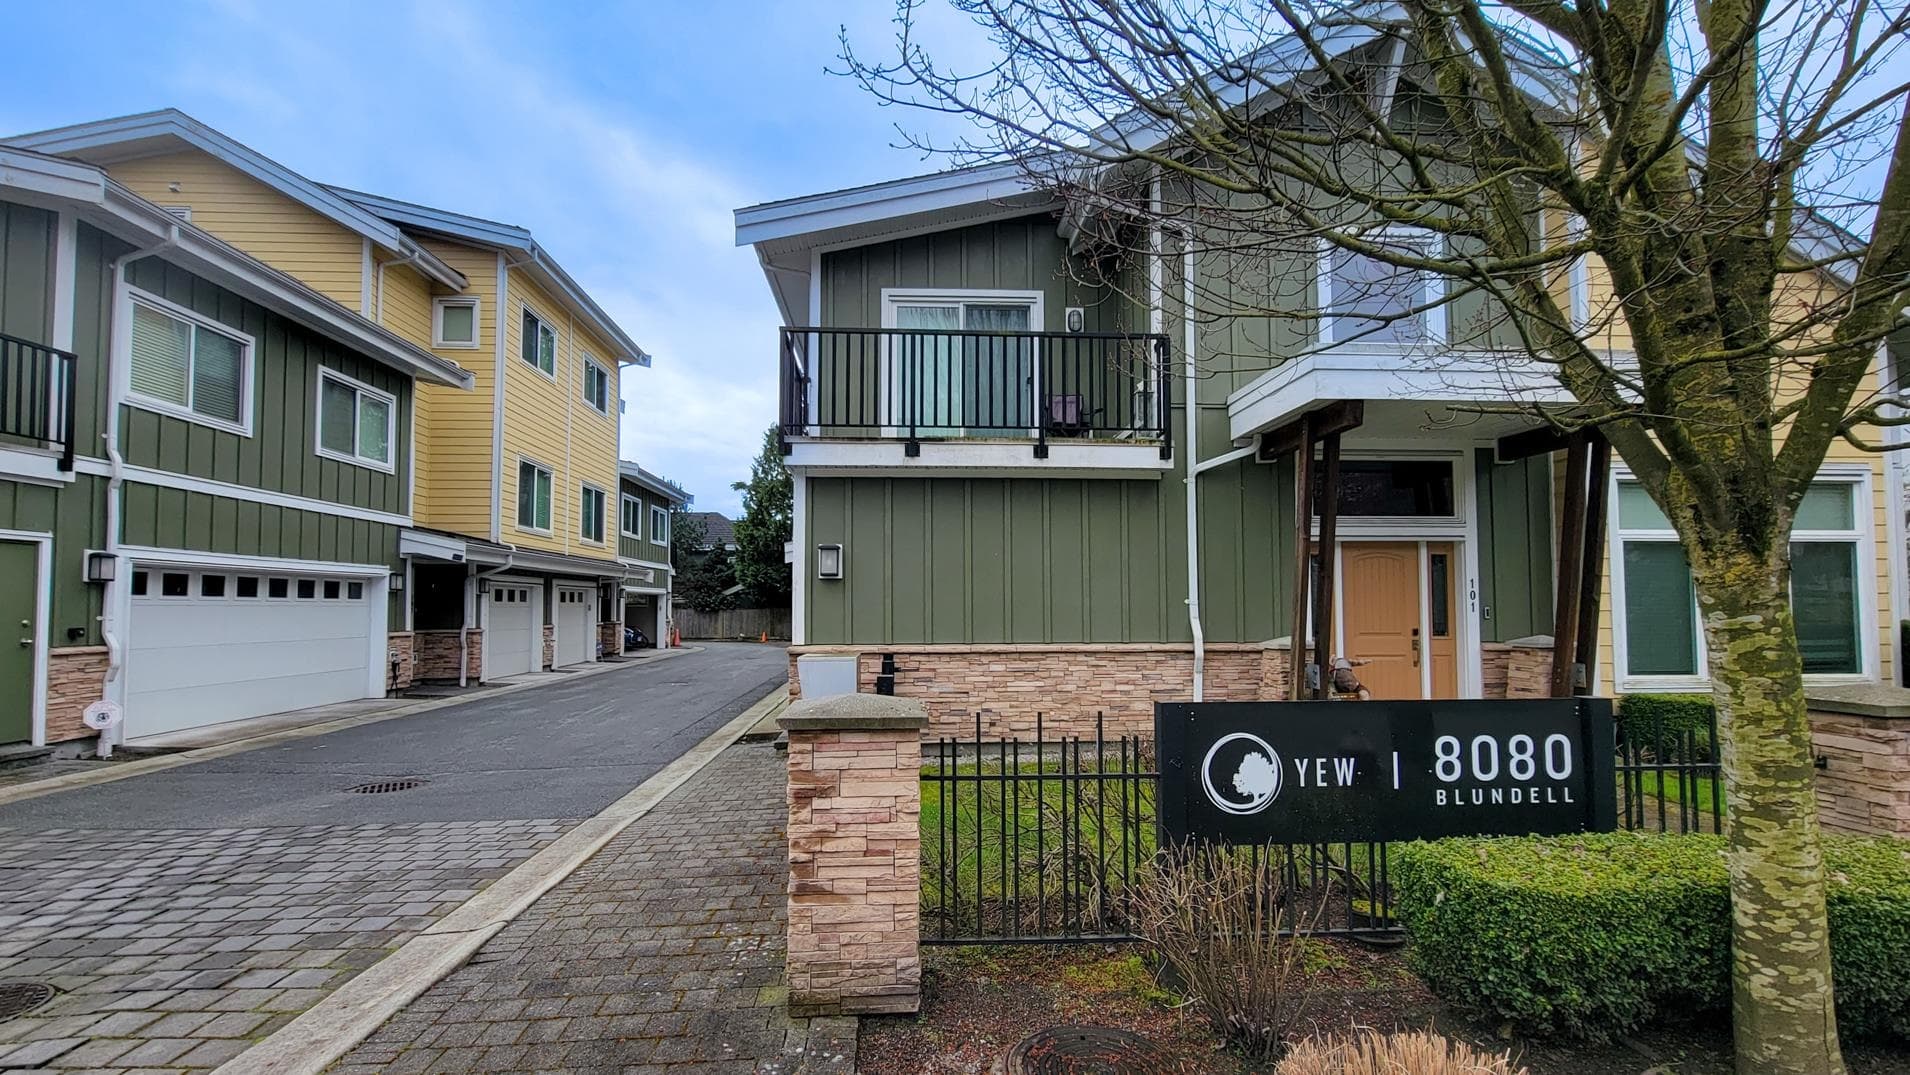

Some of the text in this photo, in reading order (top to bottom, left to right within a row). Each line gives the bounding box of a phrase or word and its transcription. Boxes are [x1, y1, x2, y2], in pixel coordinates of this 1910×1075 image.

[1294, 733, 1573, 787] YEW 8080
[1436, 787, 1574, 806] BLUNDELL
